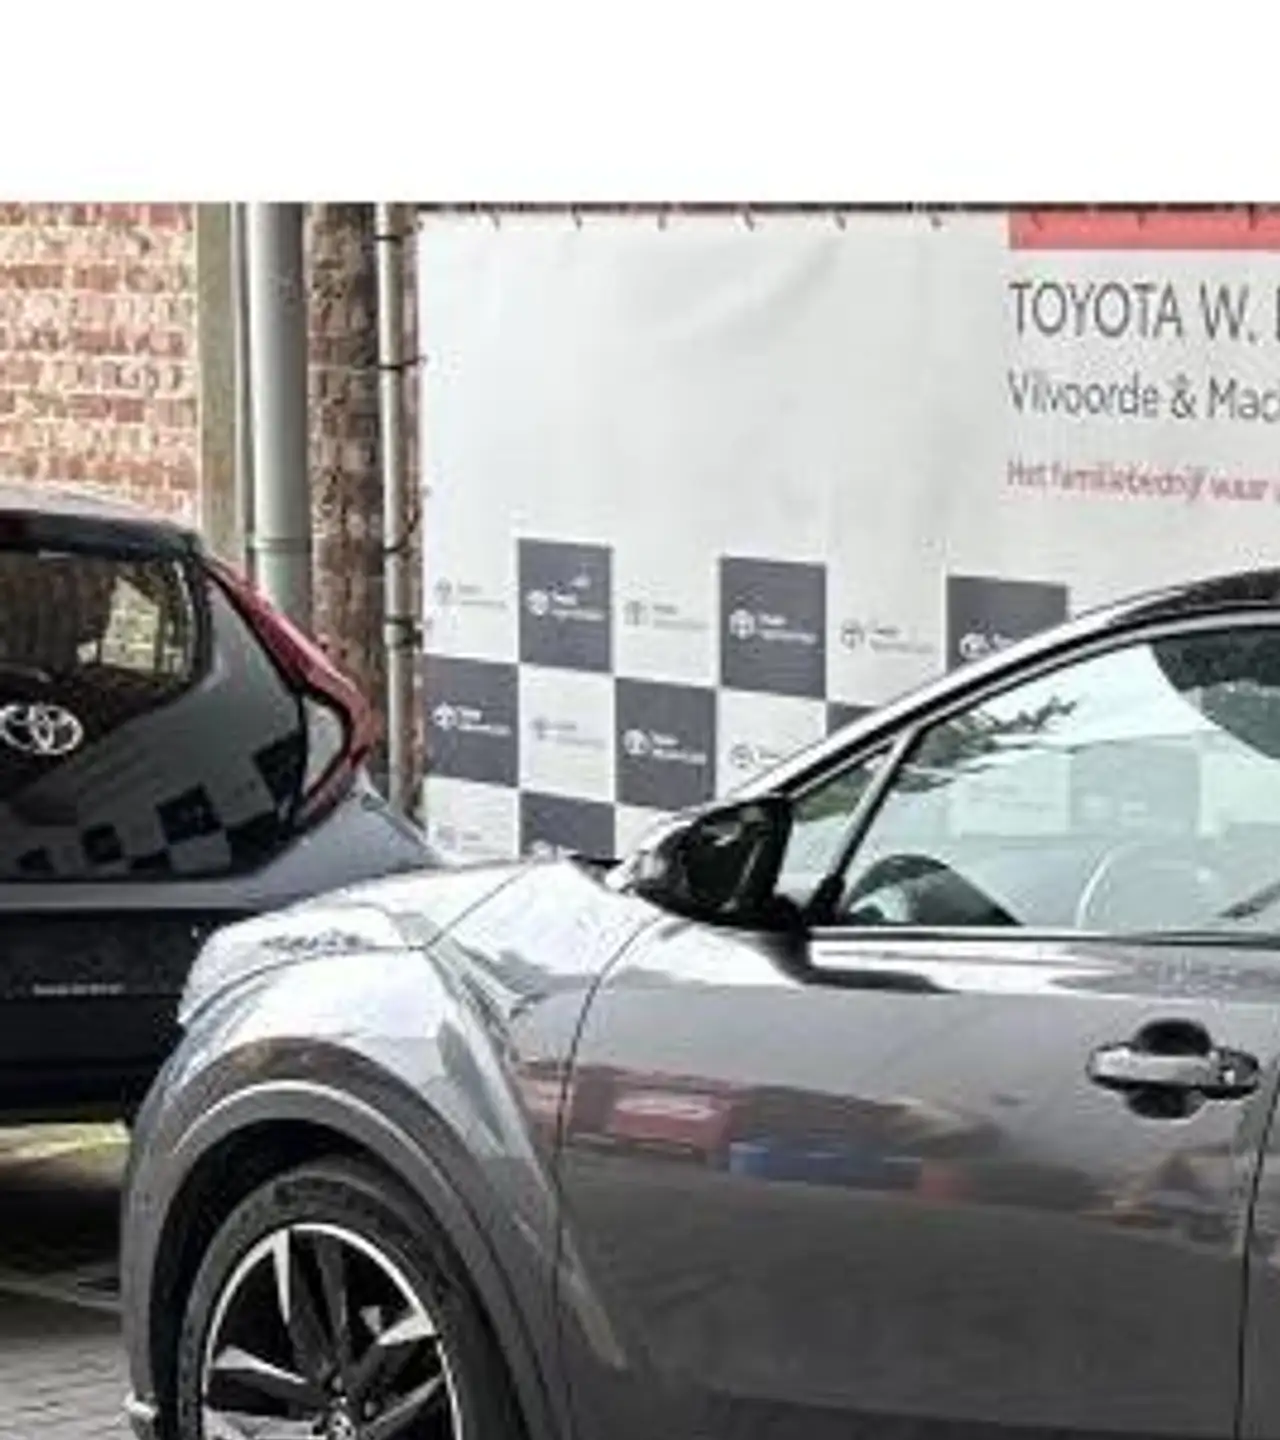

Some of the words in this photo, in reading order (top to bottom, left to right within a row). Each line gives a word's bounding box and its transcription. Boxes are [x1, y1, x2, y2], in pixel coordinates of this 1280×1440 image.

[1008, 282, 1184, 340] TOYOTA
[1199, 284, 1257, 344] W.
[1006, 370, 1160, 420] Vilvoorde
[1170, 374, 1195, 420] &
